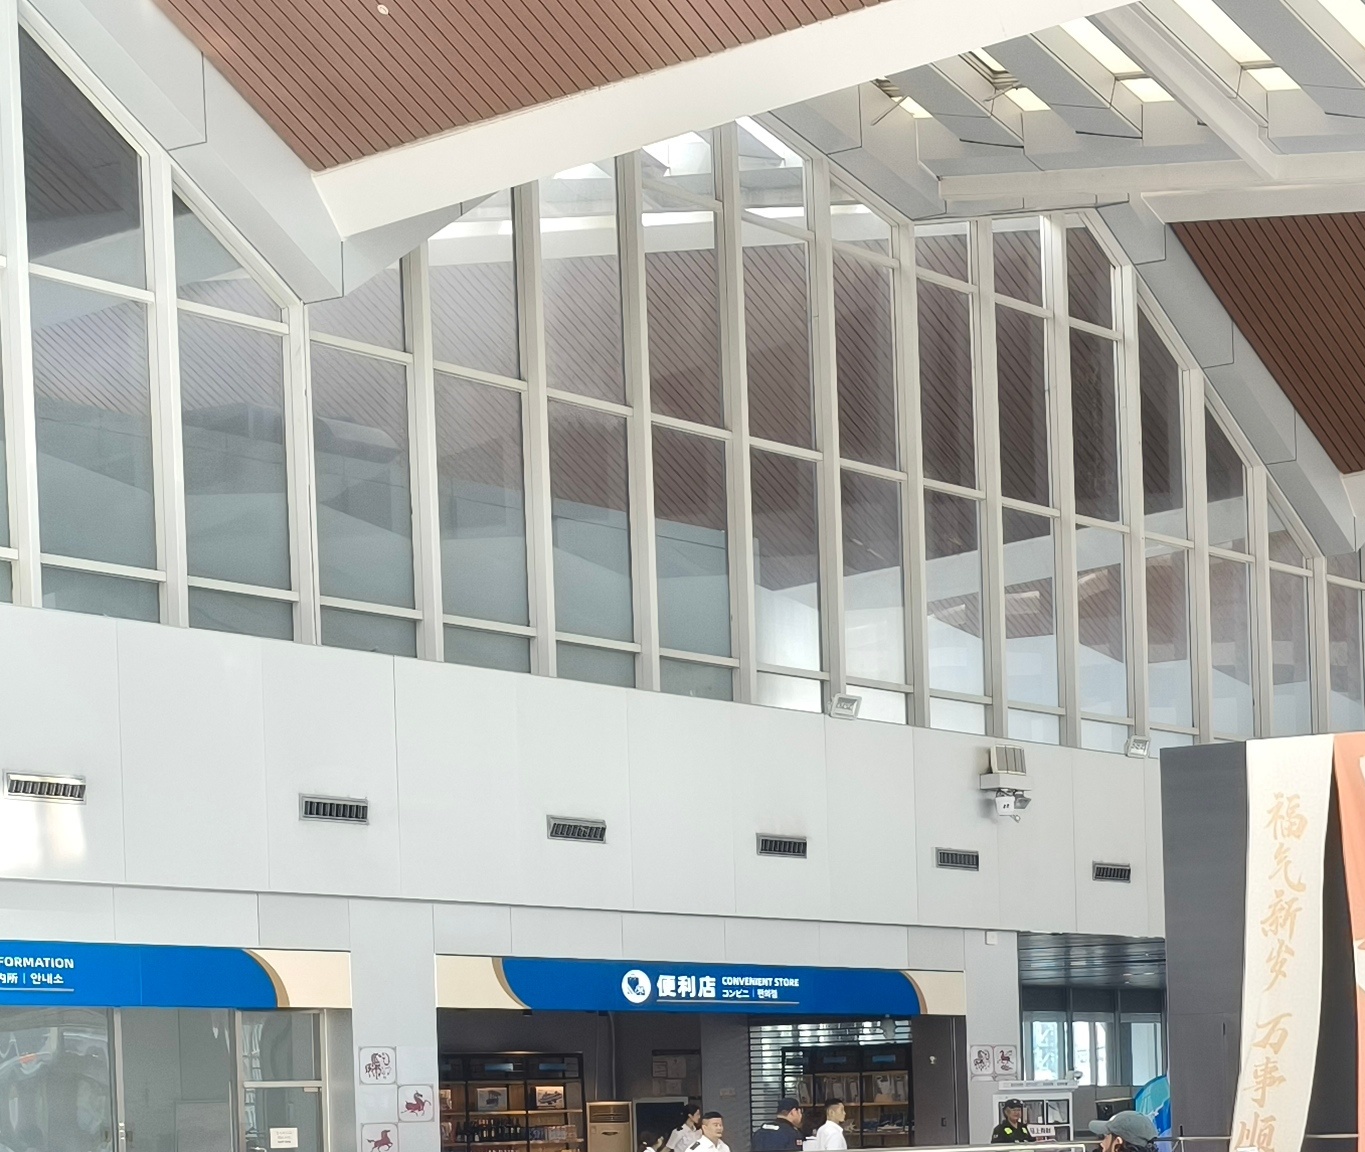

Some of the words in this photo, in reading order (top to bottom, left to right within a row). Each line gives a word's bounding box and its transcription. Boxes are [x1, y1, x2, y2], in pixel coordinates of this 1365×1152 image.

[656, 974, 716, 998] 便利店
[721, 976, 773, 986] CONVENIENT
[774, 977, 800, 987] STORE
